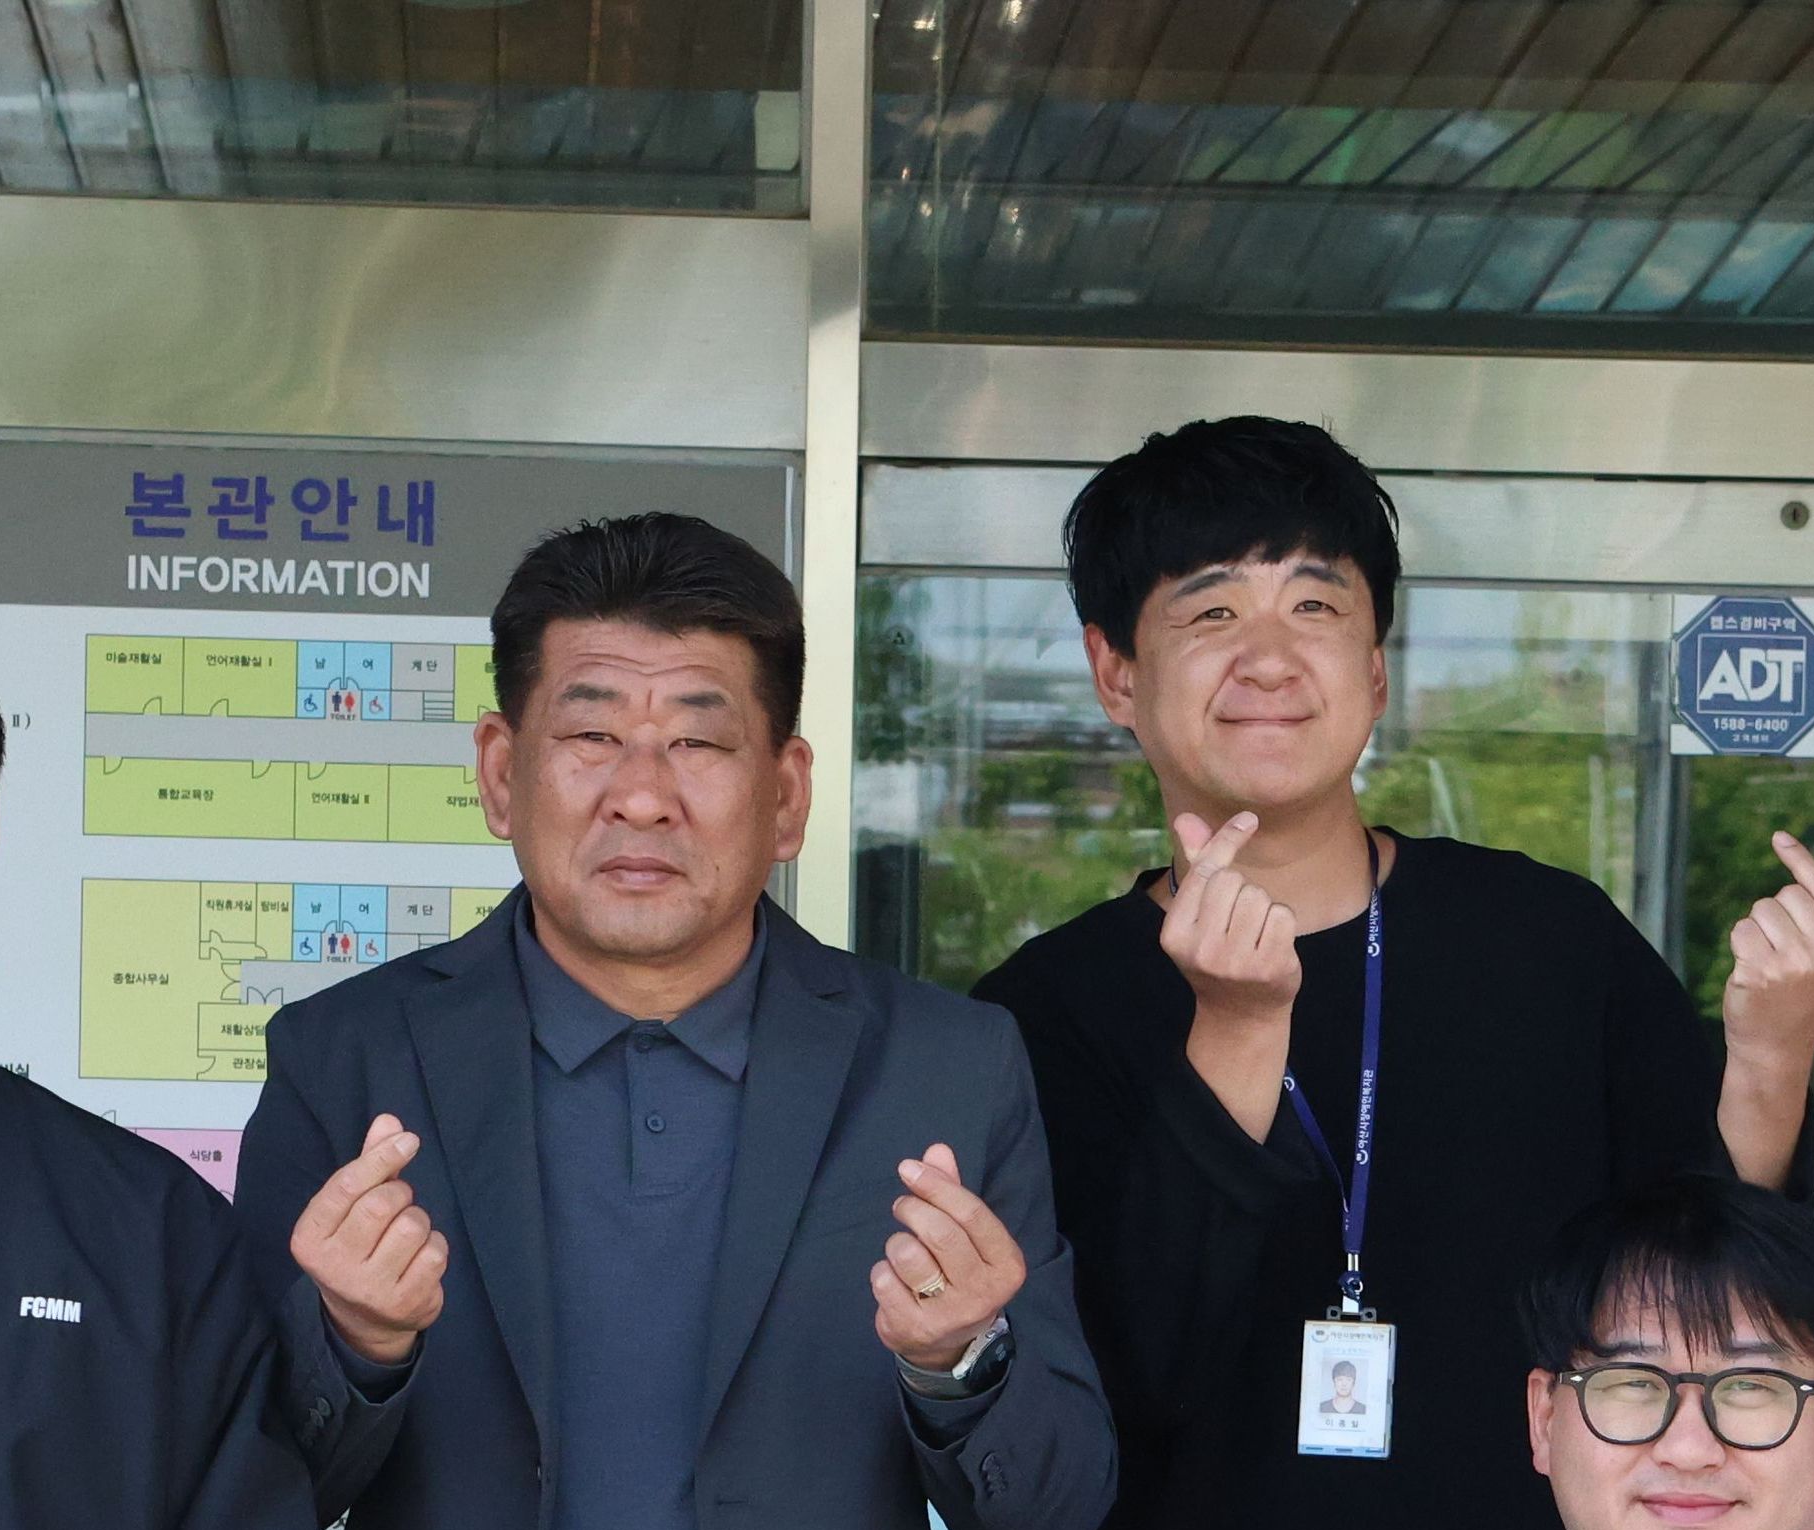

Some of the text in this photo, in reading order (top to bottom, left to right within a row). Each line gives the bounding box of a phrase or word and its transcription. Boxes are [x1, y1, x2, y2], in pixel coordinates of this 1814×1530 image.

[125, 472, 437, 547] 본관안내
[127, 554, 430, 598] INFORMATION
[106, 652, 162, 665] 미술재활실
[206, 654, 262, 667] 언어재활실
[315, 657, 326, 670] 남
[362, 658, 374, 670] 여
[1698, 647, 1806, 703] ADT
[1713, 717, 1789, 732] 1588-6400
[311, 902, 322, 914] 남
[358, 903, 370, 914] 여
[113, 972, 170, 985] 종합사무실
[1358, 1069, 1374, 1148] 아산시장애인복지관
[20, 1296, 82, 1323] FCMM
